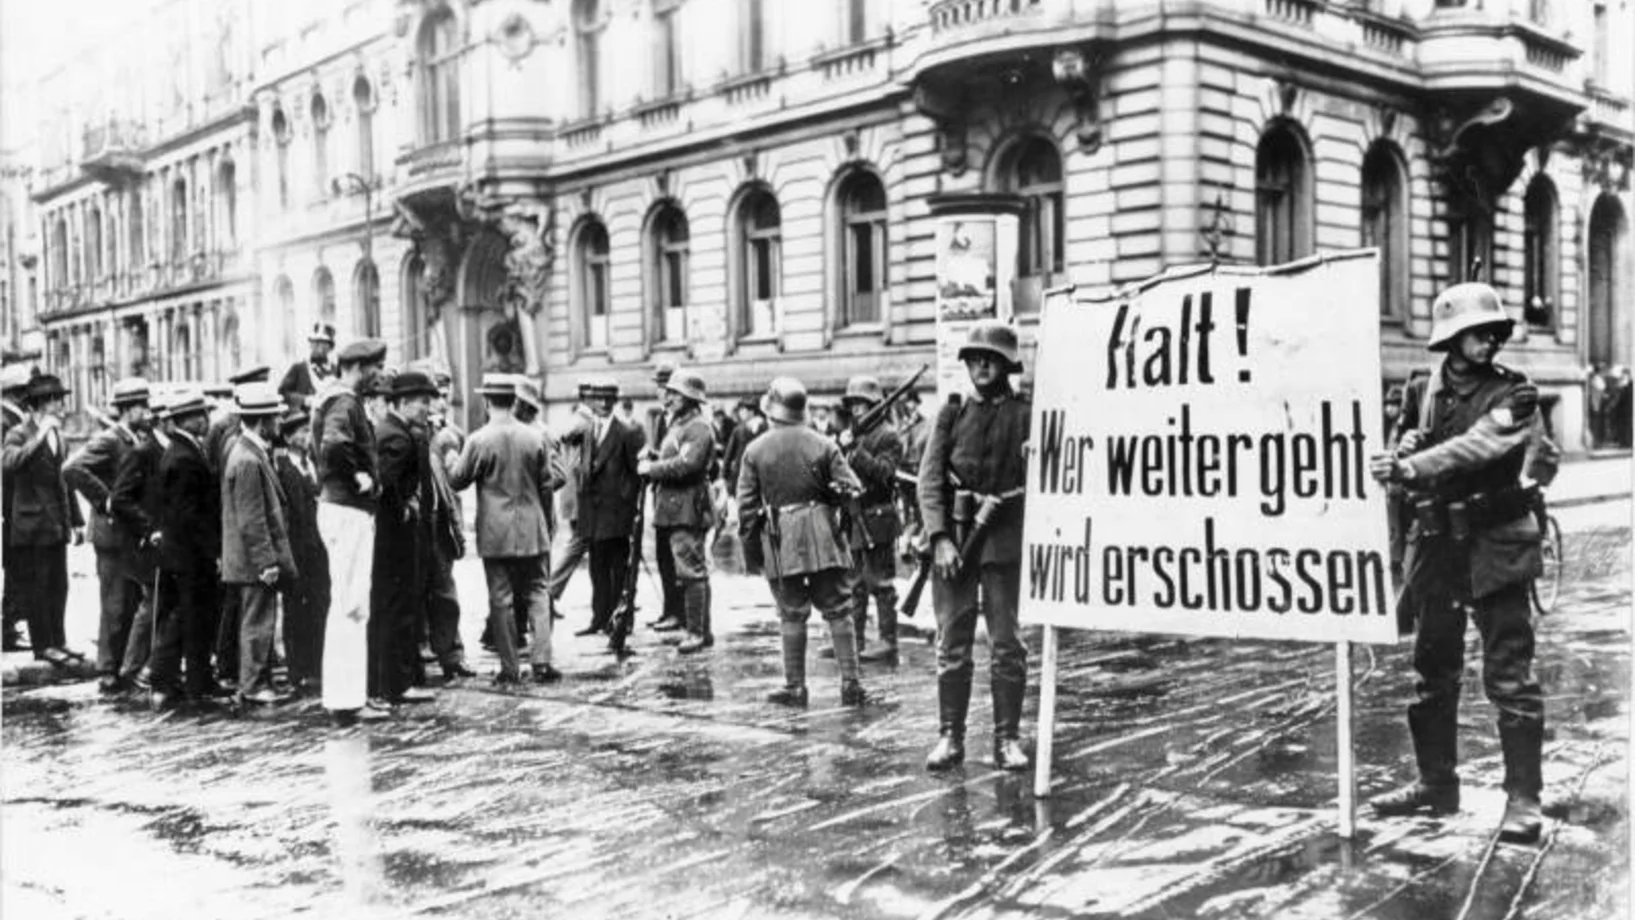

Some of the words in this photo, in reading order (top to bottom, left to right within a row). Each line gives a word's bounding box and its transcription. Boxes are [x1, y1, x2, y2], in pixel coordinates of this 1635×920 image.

[1039, 409, 1094, 495] Wer
[1029, 517, 1092, 604] wird
[1102, 518, 1387, 615] erschossen
